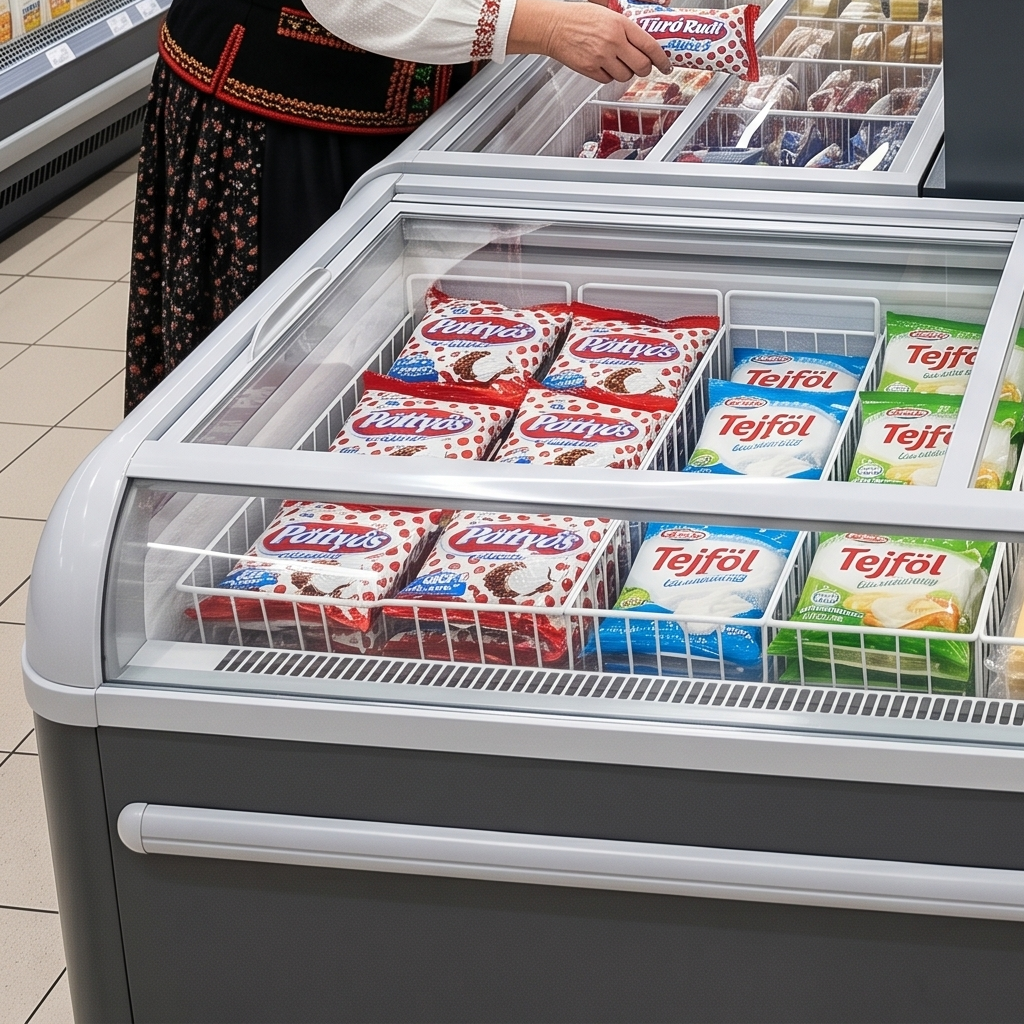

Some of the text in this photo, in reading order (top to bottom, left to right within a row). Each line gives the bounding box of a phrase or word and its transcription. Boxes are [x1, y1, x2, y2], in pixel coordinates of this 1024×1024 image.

[746, 369, 839, 389] Tejföl
[718, 413, 817, 442] Tejföl
[883, 423, 956, 451] Tejf
[652, 546, 760, 577] Tejföl
[840, 547, 947, 579] Tejföl
